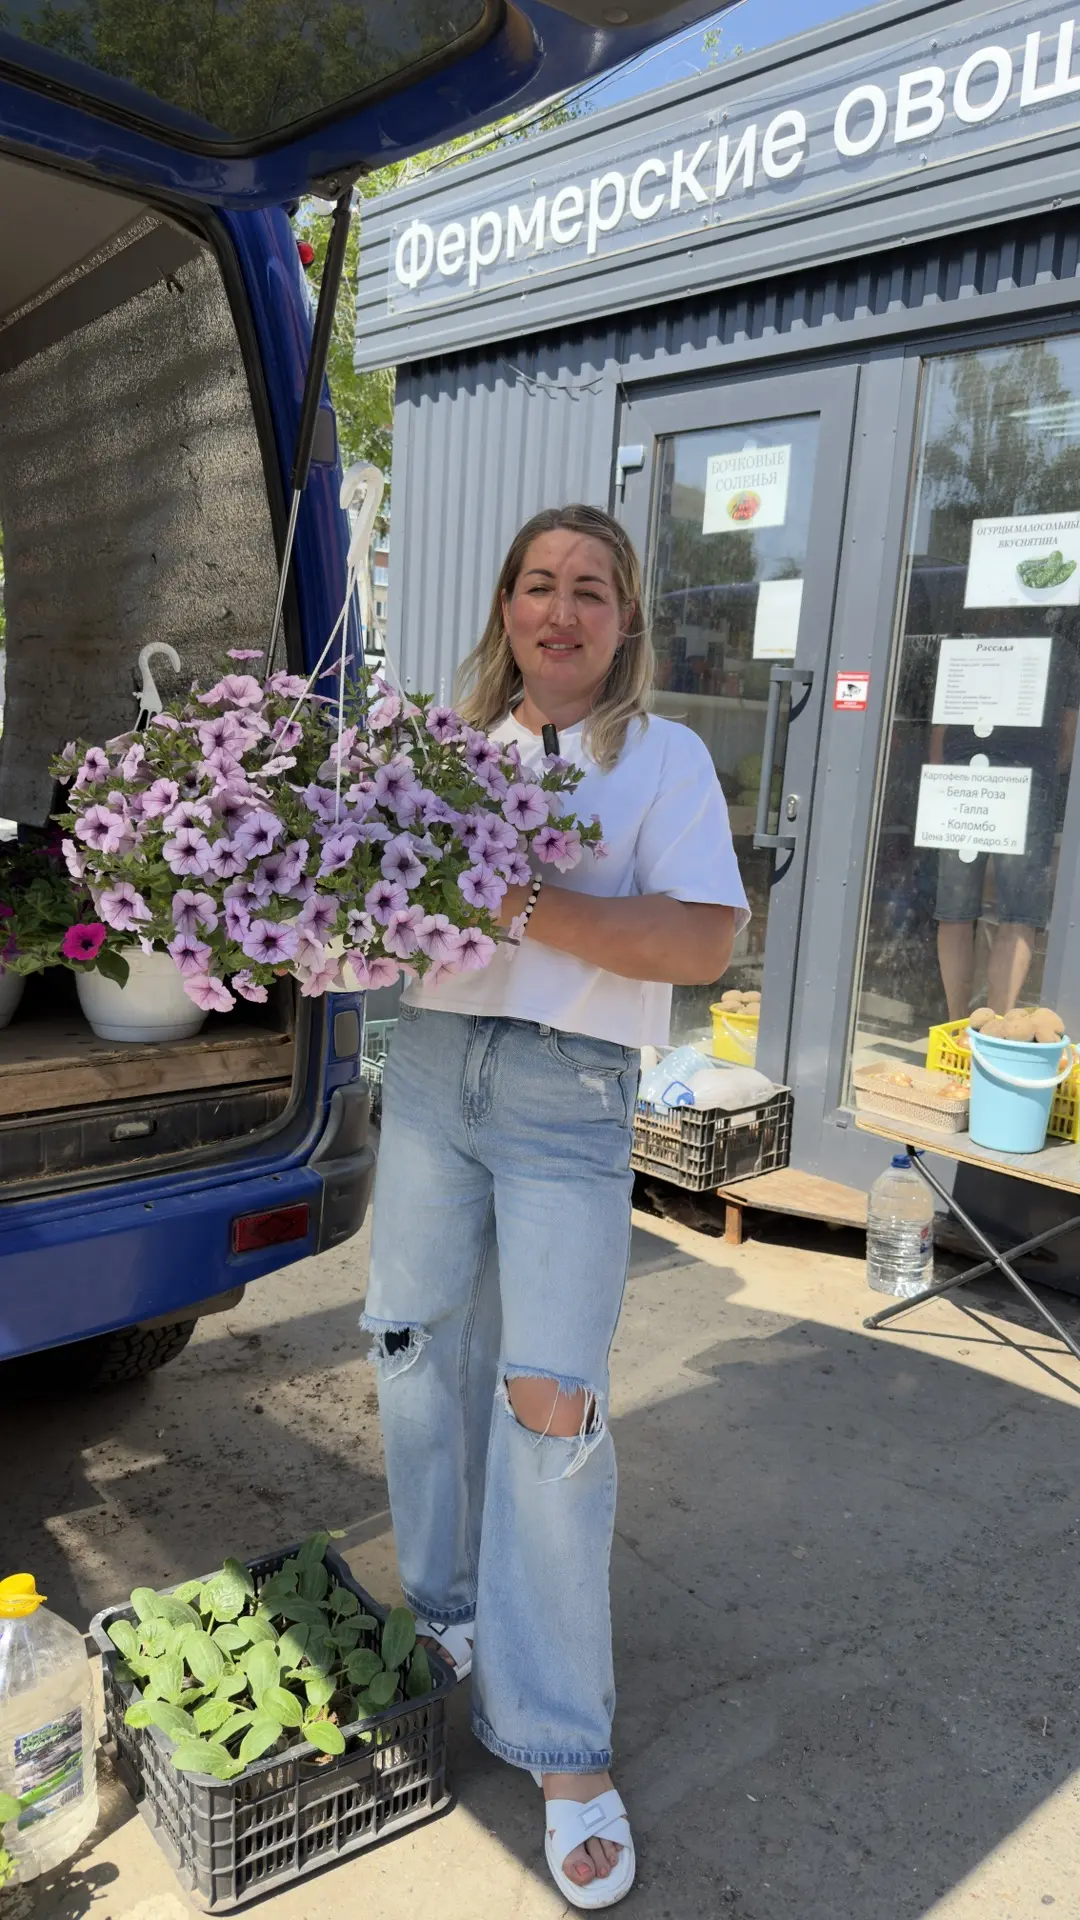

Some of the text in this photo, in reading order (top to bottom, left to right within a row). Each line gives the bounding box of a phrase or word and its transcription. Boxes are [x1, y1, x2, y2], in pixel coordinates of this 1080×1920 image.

[395, 110, 807, 288] Фермерские
[711, 452, 784, 474] БОЧКОВЫЕ
[716, 472, 777, 492] СОЛЕНЬЯ
[977, 520, 1080, 535] ОГУРЦЫ МАЛОСОЛЬНЫ
[997, 536, 1058, 548] ВКУСНЯТИНА
[976, 643, 1014, 652] Рассада
[923, 771, 1029, 784] Картофель посадочный
[946, 786, 978, 797] Белая
[980, 787, 1006, 800] Роза
[959, 803, 989, 815] Галла
[947, 818, 996, 832] Коломбо
[921, 831, 943, 842] Цена
[973, 837, 1001, 847] ведро
[1003, 837, 1009, 847] 5
